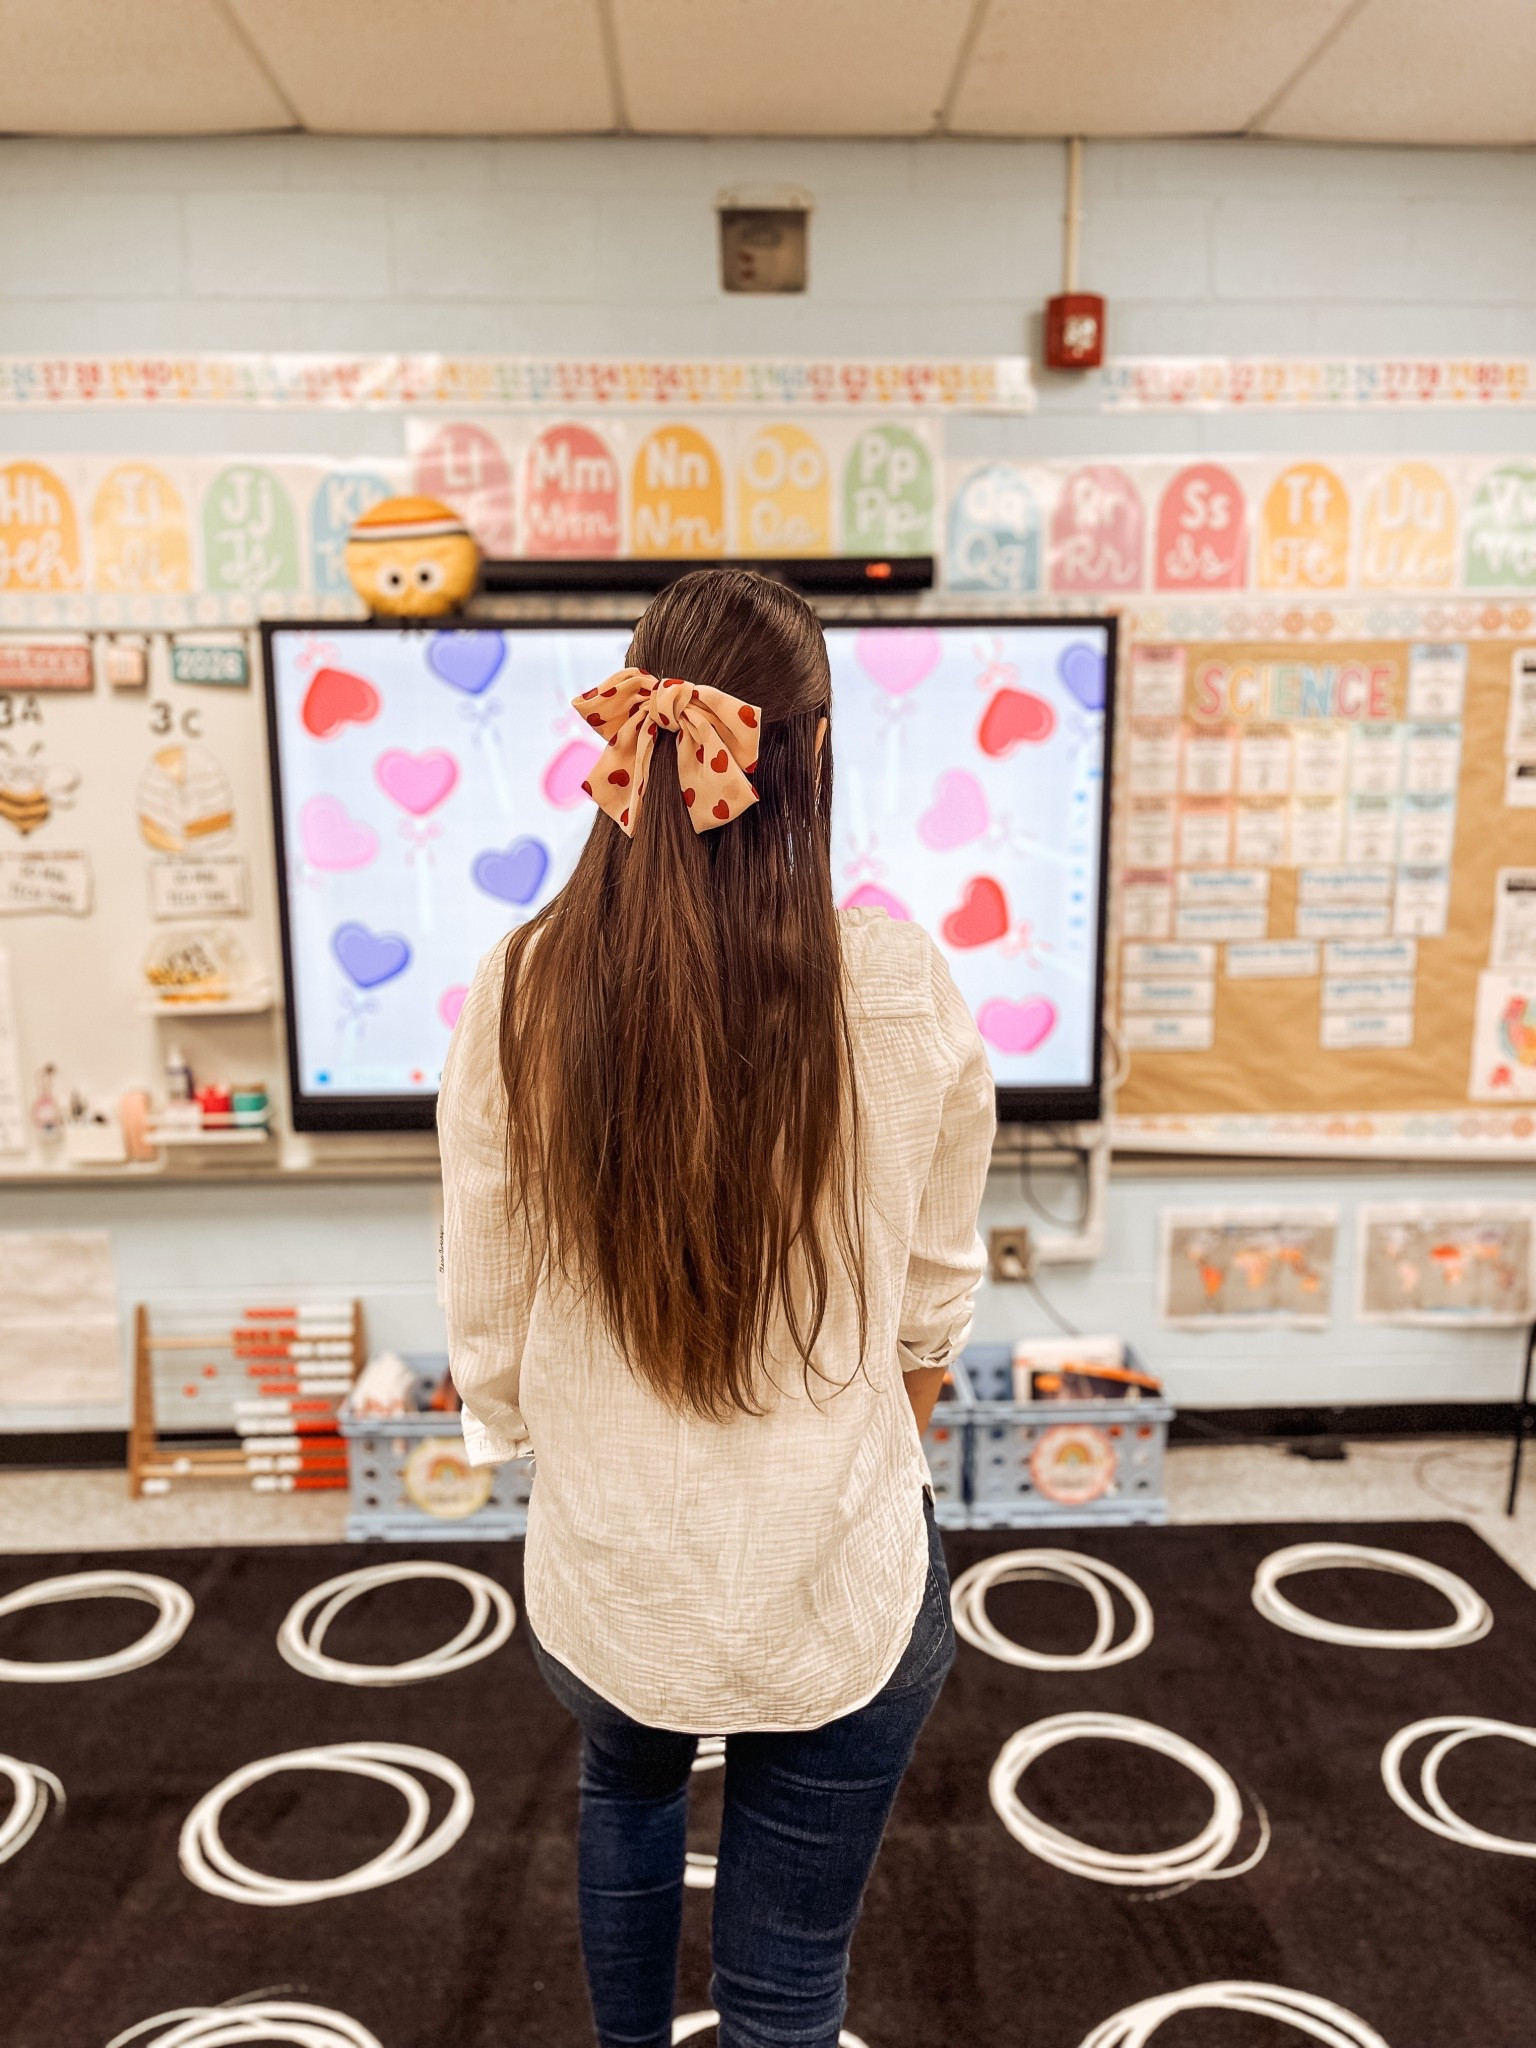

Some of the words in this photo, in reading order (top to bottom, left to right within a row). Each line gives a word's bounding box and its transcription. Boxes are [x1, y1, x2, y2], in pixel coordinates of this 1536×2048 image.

[536, 437, 615, 492] Mm
[646, 436, 711, 490] Nn
[746, 436, 823, 492] Oo
[858, 432, 918, 499] Pp
[0, 472, 62, 526] Hh
[219, 470, 278, 539] Jj
[635, 500, 726, 550] Nn
[852, 486, 930, 558] Pp
[1178, 477, 1231, 530] Ss
[1284, 473, 1333, 526] Tt
[1379, 475, 1446, 532] Uu
[1198, 664, 1392, 718] SCIENCE
